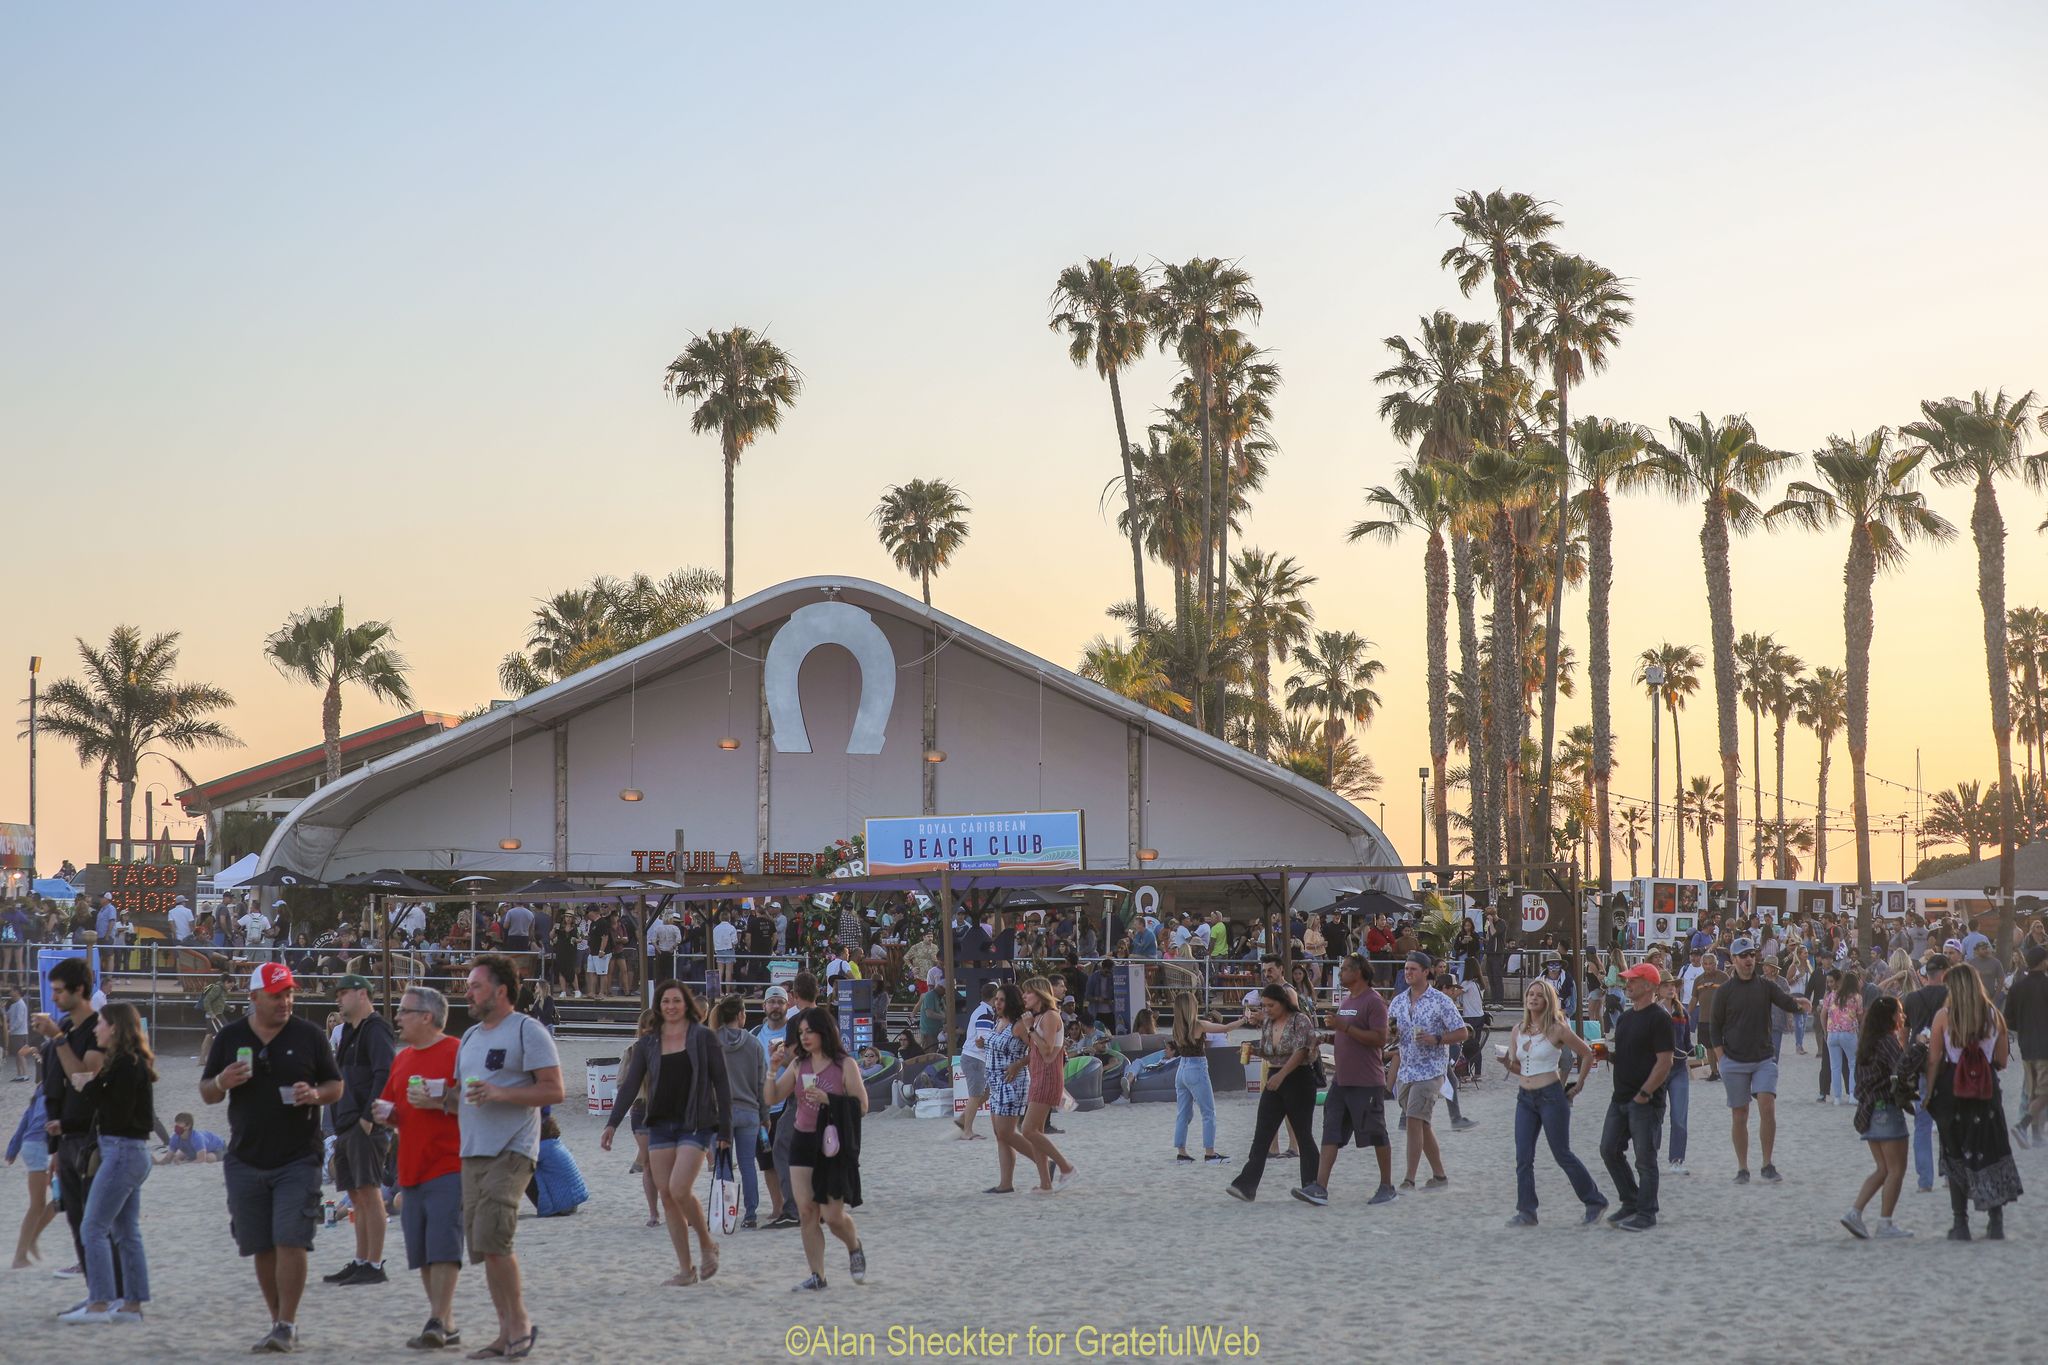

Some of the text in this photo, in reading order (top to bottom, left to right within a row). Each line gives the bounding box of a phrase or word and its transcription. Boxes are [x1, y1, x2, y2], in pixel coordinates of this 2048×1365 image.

[919, 820, 1026, 835] ROYAL CARIBBEAN
[904, 834, 1043, 859] BEACH CLUB
[107, 864, 177, 887] TACO
[111, 891, 177, 913] SHOP
